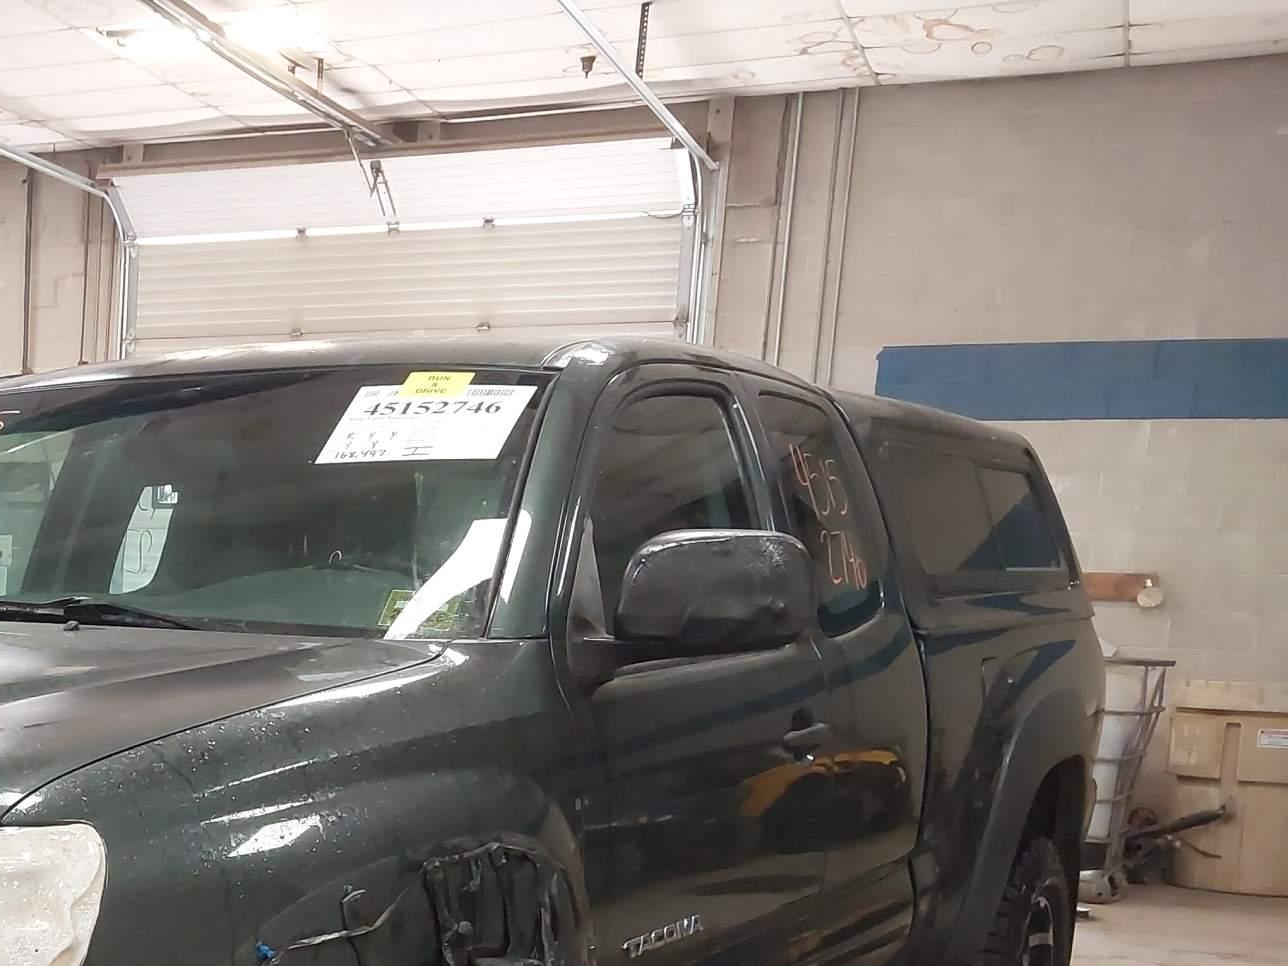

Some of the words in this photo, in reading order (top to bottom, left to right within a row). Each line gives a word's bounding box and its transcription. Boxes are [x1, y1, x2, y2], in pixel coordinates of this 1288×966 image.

[363, 400, 505, 416] 45152746
[788, 443, 848, 521] 4515
[621, 914, 704, 959] TACOMA
